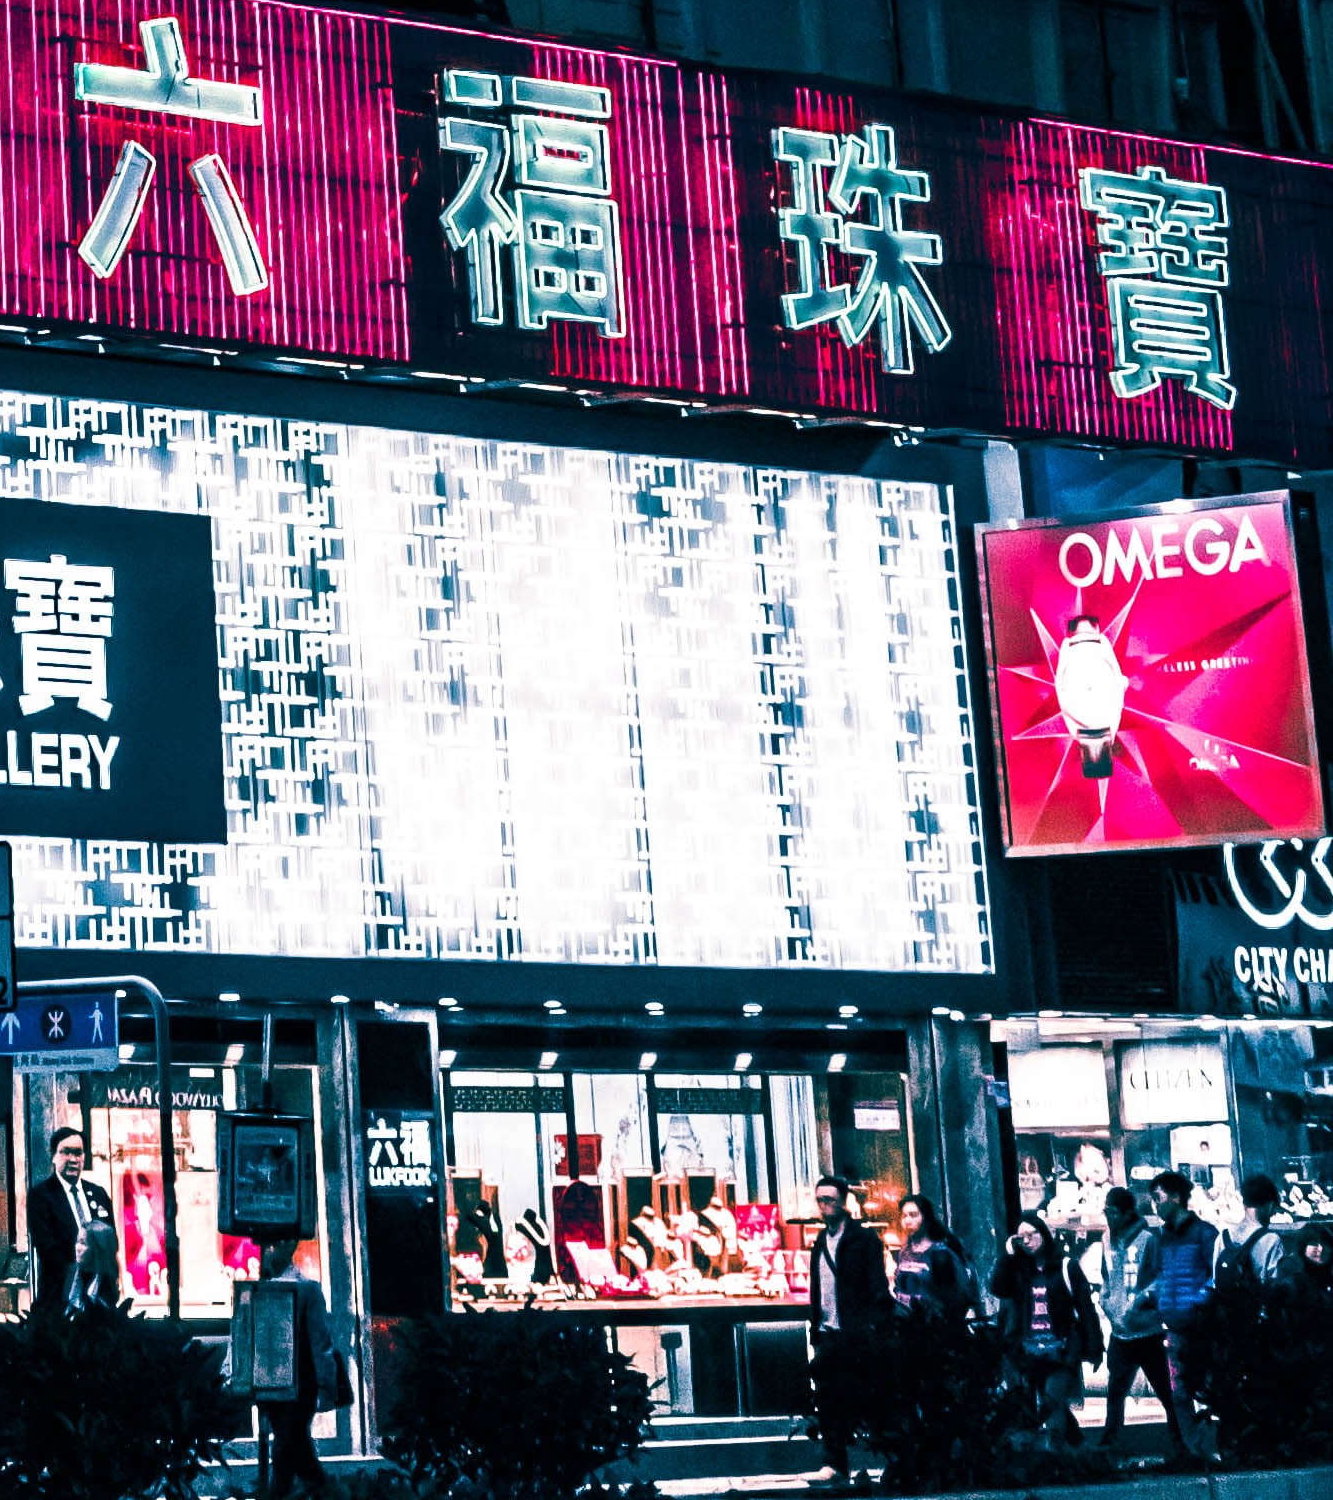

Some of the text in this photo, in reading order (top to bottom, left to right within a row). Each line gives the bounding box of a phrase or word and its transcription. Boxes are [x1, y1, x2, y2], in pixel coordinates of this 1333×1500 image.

[72, 13, 1238, 412] 六福珠寶
[1058, 512, 1272, 589] OMEGA
[1234, 945, 1287, 984] CITY
[367, 1118, 431, 1166] 六福
[369, 1166, 432, 1187] LUKFOOK
